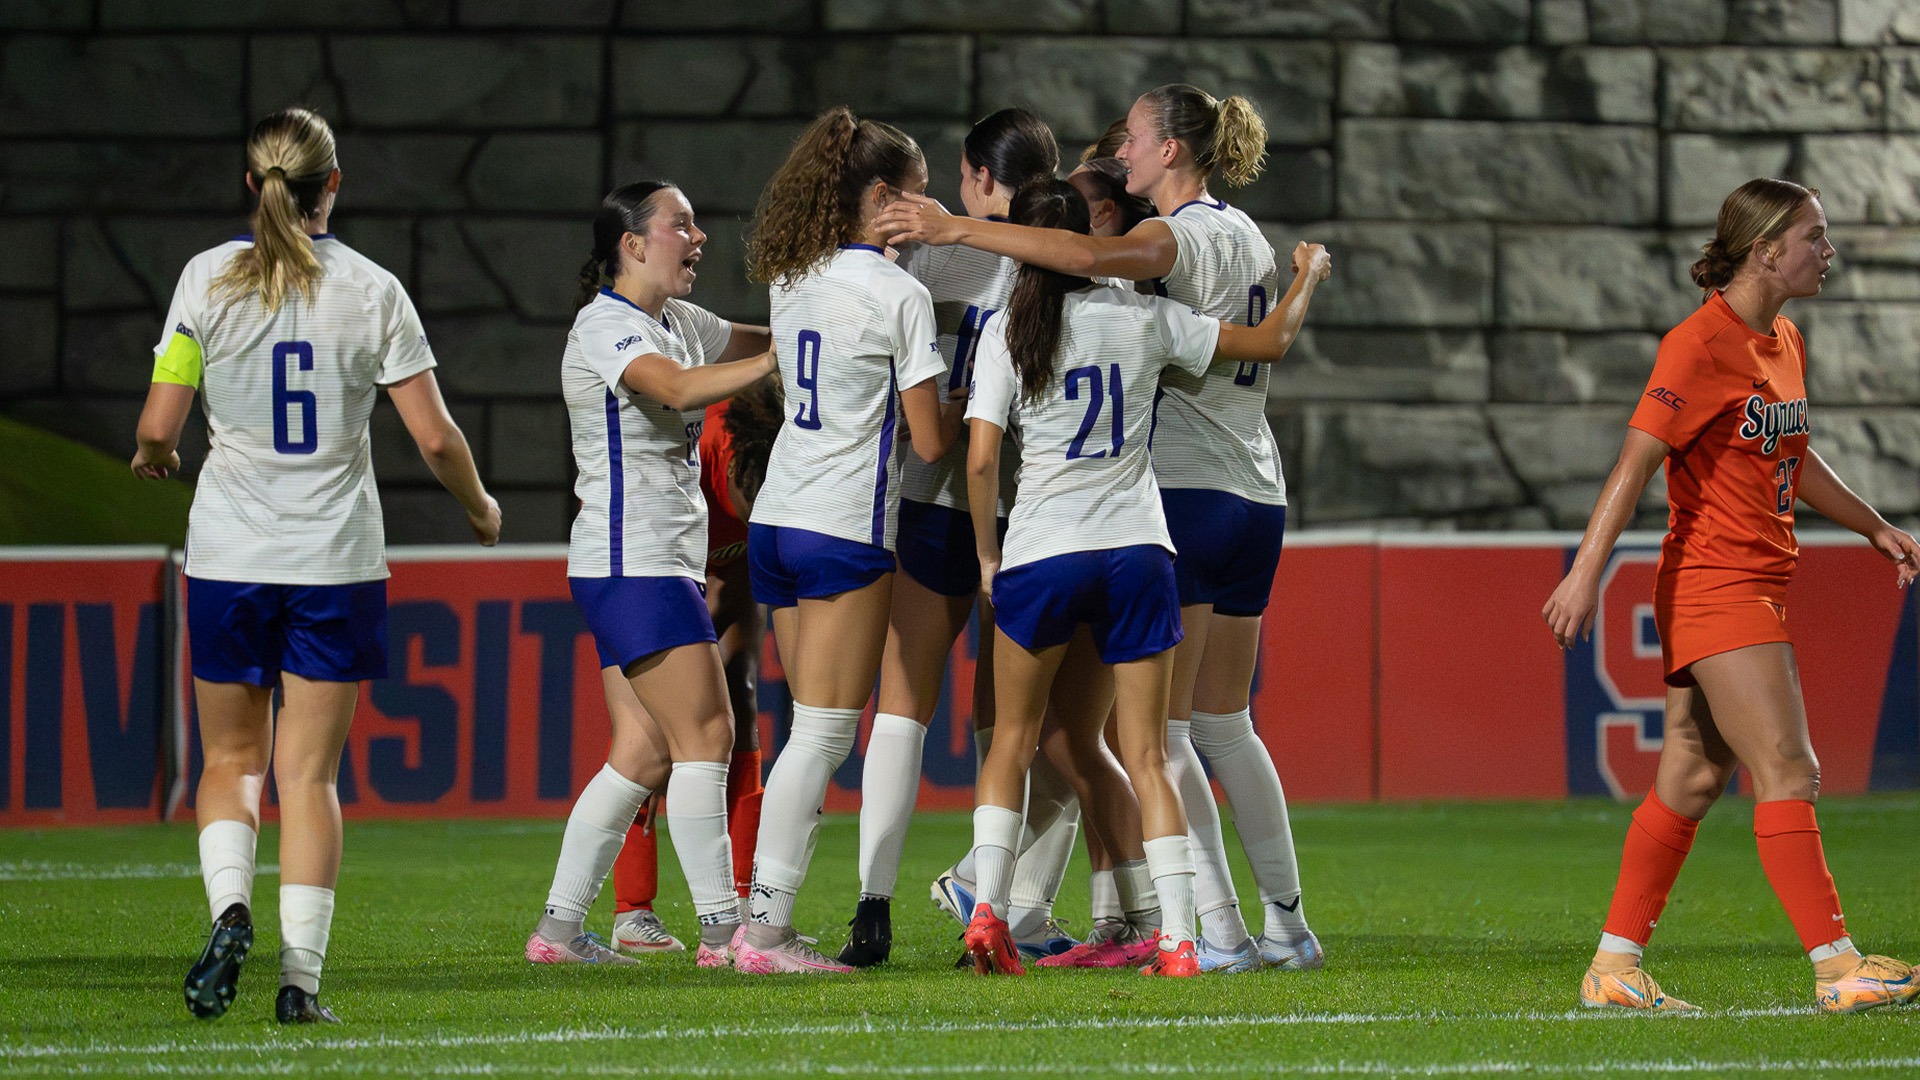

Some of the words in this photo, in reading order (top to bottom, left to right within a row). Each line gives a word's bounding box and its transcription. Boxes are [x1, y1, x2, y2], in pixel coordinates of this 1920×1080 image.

[272, 341, 318, 455] 6
[794, 328, 822, 431] 9
[1065, 363, 1125, 461] 21
[1646, 386, 1687, 412] ACC
